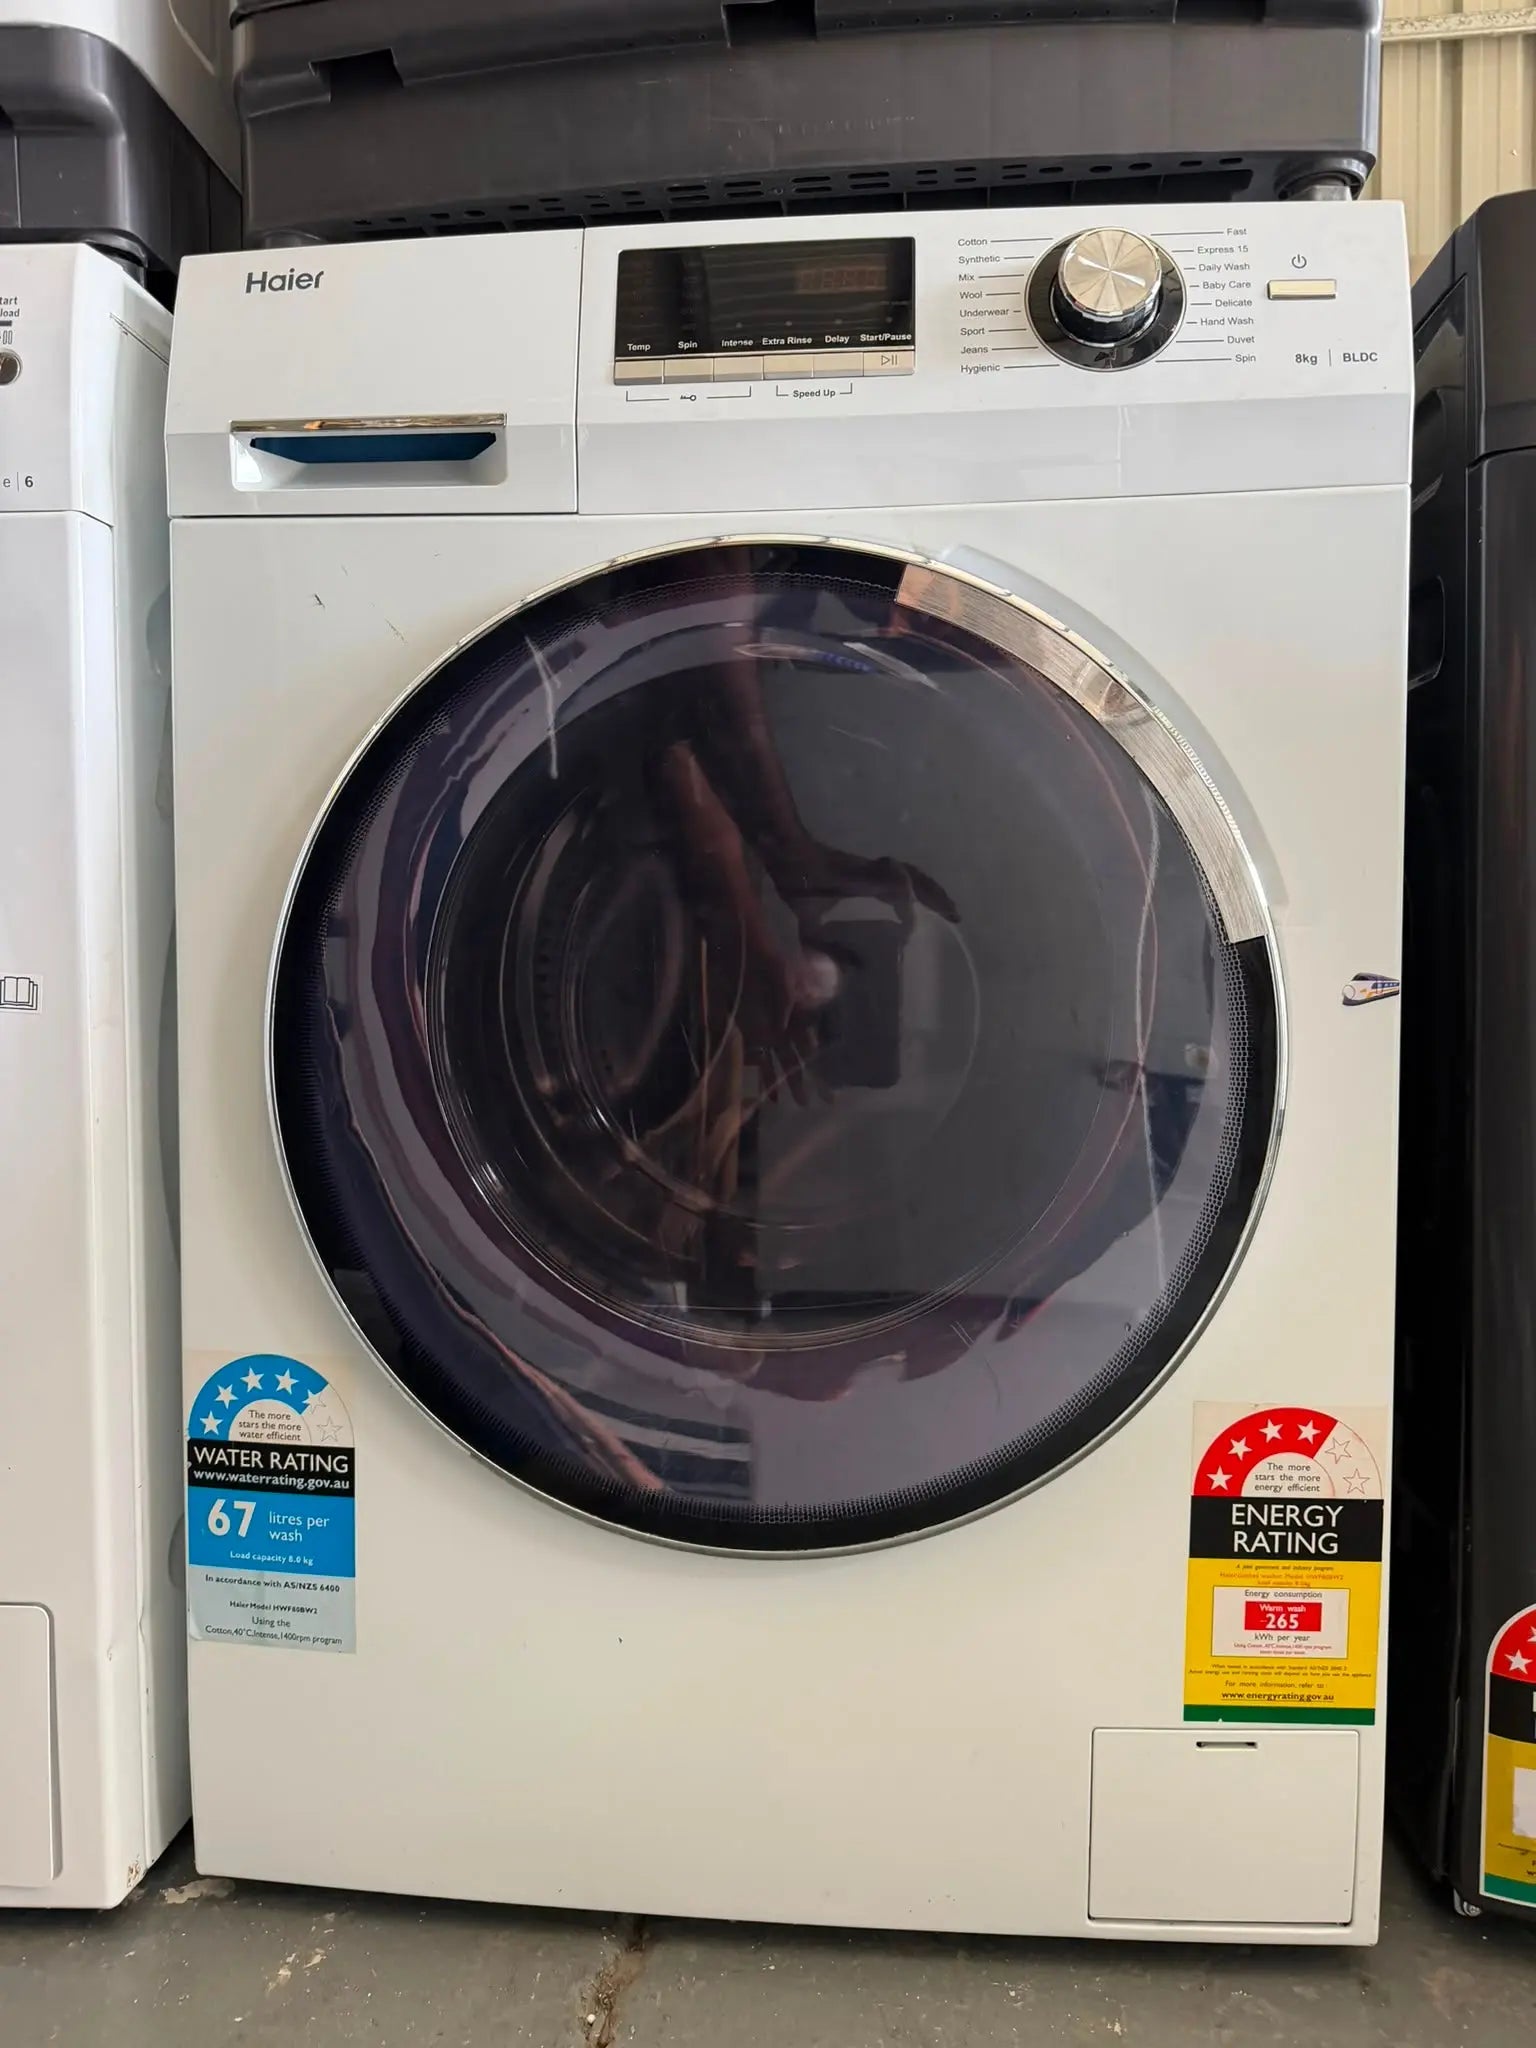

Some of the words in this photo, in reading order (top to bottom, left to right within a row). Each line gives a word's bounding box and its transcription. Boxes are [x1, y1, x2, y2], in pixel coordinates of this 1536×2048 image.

[1227, 228, 1247, 236] Fast
[958, 238, 988, 247] Cotton
[1197, 246, 1235, 255] Express
[1238, 245, 1249, 253] 15
[958, 255, 1000, 266] Synthetic
[1199, 263, 1222, 273] Daily
[1224, 262, 1250, 271] Wash
[245, 267, 324, 294] Haier
[959, 273, 975, 281] Mix
[1203, 281, 1226, 290] Baby
[1229, 280, 1251, 289] Care
[960, 291, 983, 299] Wool
[1215, 299, 1253, 307] Delicate
[959, 308, 1009, 318] Underwear
[1200, 317, 1225, 326] Hand
[1228, 316, 1254, 325] Wash
[960, 327, 985, 337] Sport
[762, 337, 785, 346] Extra
[787, 336, 813, 345] Rinse
[824, 335, 850, 344] Delay
[860, 333, 912, 343] Start/Pause
[1227, 335, 1255, 344] Duvet
[627, 343, 651, 353] Temp
[678, 340, 698, 350] Spin
[721, 338, 753, 347] Intense
[960, 345, 989, 354] Jeans
[1235, 354, 1257, 363] Spin
[1295, 353, 1318, 366] 8kg
[1343, 352, 1378, 362] BLDC
[961, 364, 1001, 375] Hygienic
[793, 389, 820, 399] Speed
[823, 389, 836, 399] Up
[25, 475, 34, 488] 6
[248, 1409, 266, 1419] The
[267, 1412, 291, 1420] more
[239, 1421, 259, 1429] stars
[261, 1421, 276, 1430] the
[278, 1423, 302, 1432] more
[239, 1431, 264, 1439] water
[266, 1432, 301, 1441] efficient
[193, 1446, 263, 1469] WATER
[270, 1451, 349, 1473] RATING
[1267, 1462, 1284, 1471] The
[193, 1469, 350, 1490] www.waterrating.gov.au
[1255, 1473, 1275, 1481] stars
[1280, 1473, 1293, 1482] the
[1254, 1484, 1283, 1493] energy
[1287, 1483, 1320, 1492] efficient
[207, 1498, 256, 1538] 67
[1231, 1503, 1344, 1527] ENERGY
[269, 1511, 303, 1526] litres
[306, 1516, 330, 1530] per
[268, 1529, 303, 1542] wash
[1233, 1530, 1338, 1555] RATING
[230, 1551, 250, 1560] Load
[252, 1553, 286, 1564] capacity
[288, 1555, 301, 1564] 8.0
[303, 1556, 314, 1566] kg
[205, 1574, 214, 1582] In
[215, 1575, 261, 1587] accordance
[263, 1579, 282, 1588] with
[283, 1581, 318, 1591] AS/NZS
[319, 1584, 340, 1593] 6400
[1244, 1589, 1270, 1599] Energy
[1274, 1591, 1322, 1599] consumption
[1259, 1603, 1283, 1612] Warm
[1287, 1604, 1306, 1612] wash
[252, 1616, 275, 1627] Using
[277, 1619, 291, 1628] the
[1265, 1613, 1299, 1629] 265
[312, 1636, 342, 1646] program
[1254, 1633, 1274, 1641] kWh
[1294, 1635, 1310, 1643] year
